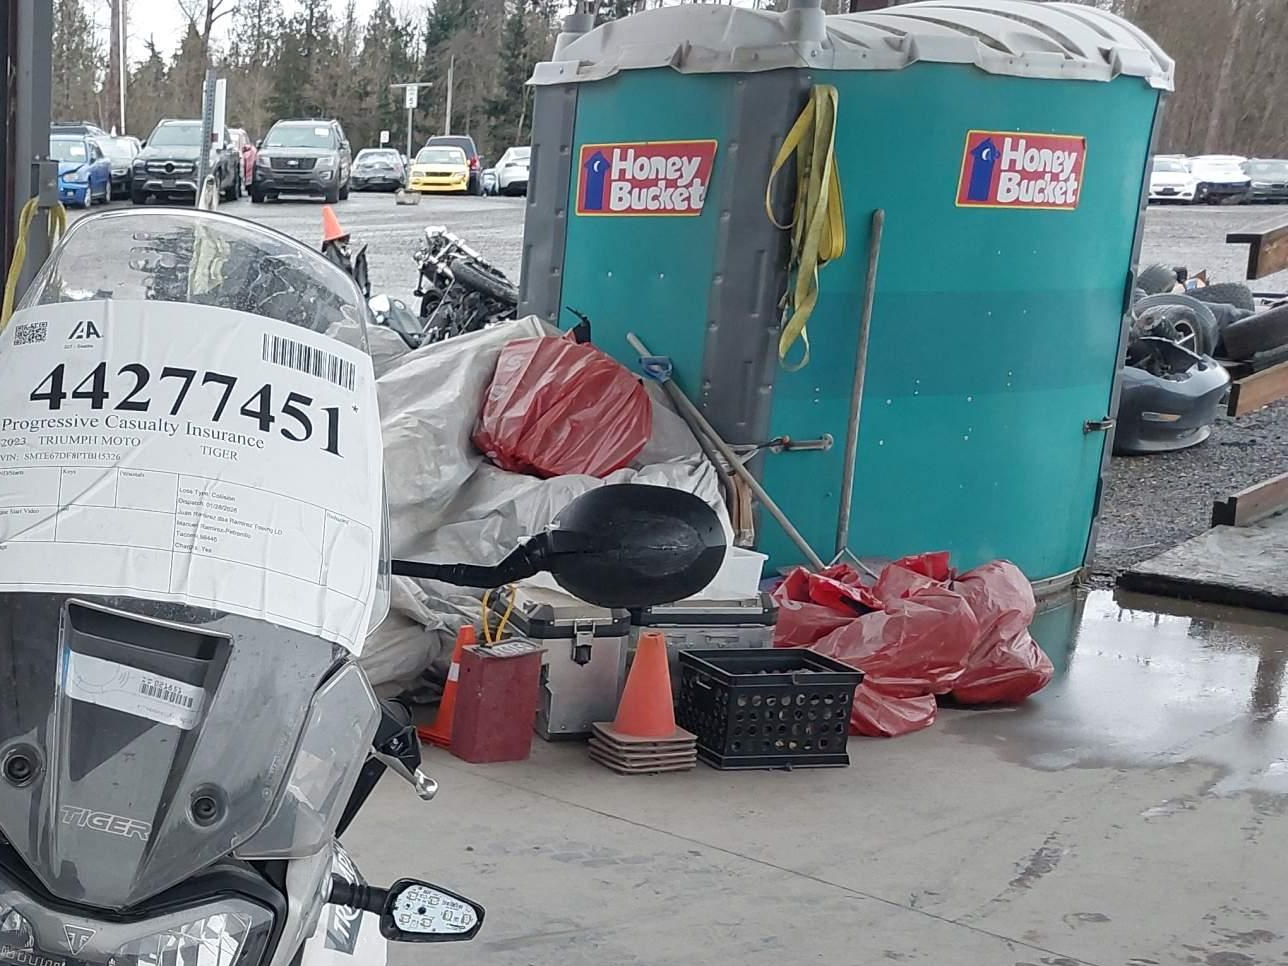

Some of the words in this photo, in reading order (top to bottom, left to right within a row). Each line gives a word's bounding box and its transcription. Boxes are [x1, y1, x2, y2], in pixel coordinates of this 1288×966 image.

[612, 148, 701, 185] Honey
[1000, 138, 1078, 178] Honey
[610, 178, 705, 211] Bucket
[997, 172, 1078, 204] Bucket
[0, 437, 27, 448] 2023
[39, 435, 98, 446] TRIUMPH
[101, 435, 142, 447] MOTO
[200, 445, 239, 461] TIGER
[1, 414, 100, 433] Progressive
[105, 415, 180, 437] Casualty
[186, 421, 265, 449] Insurance
[62, 804, 153, 841] TIGER
